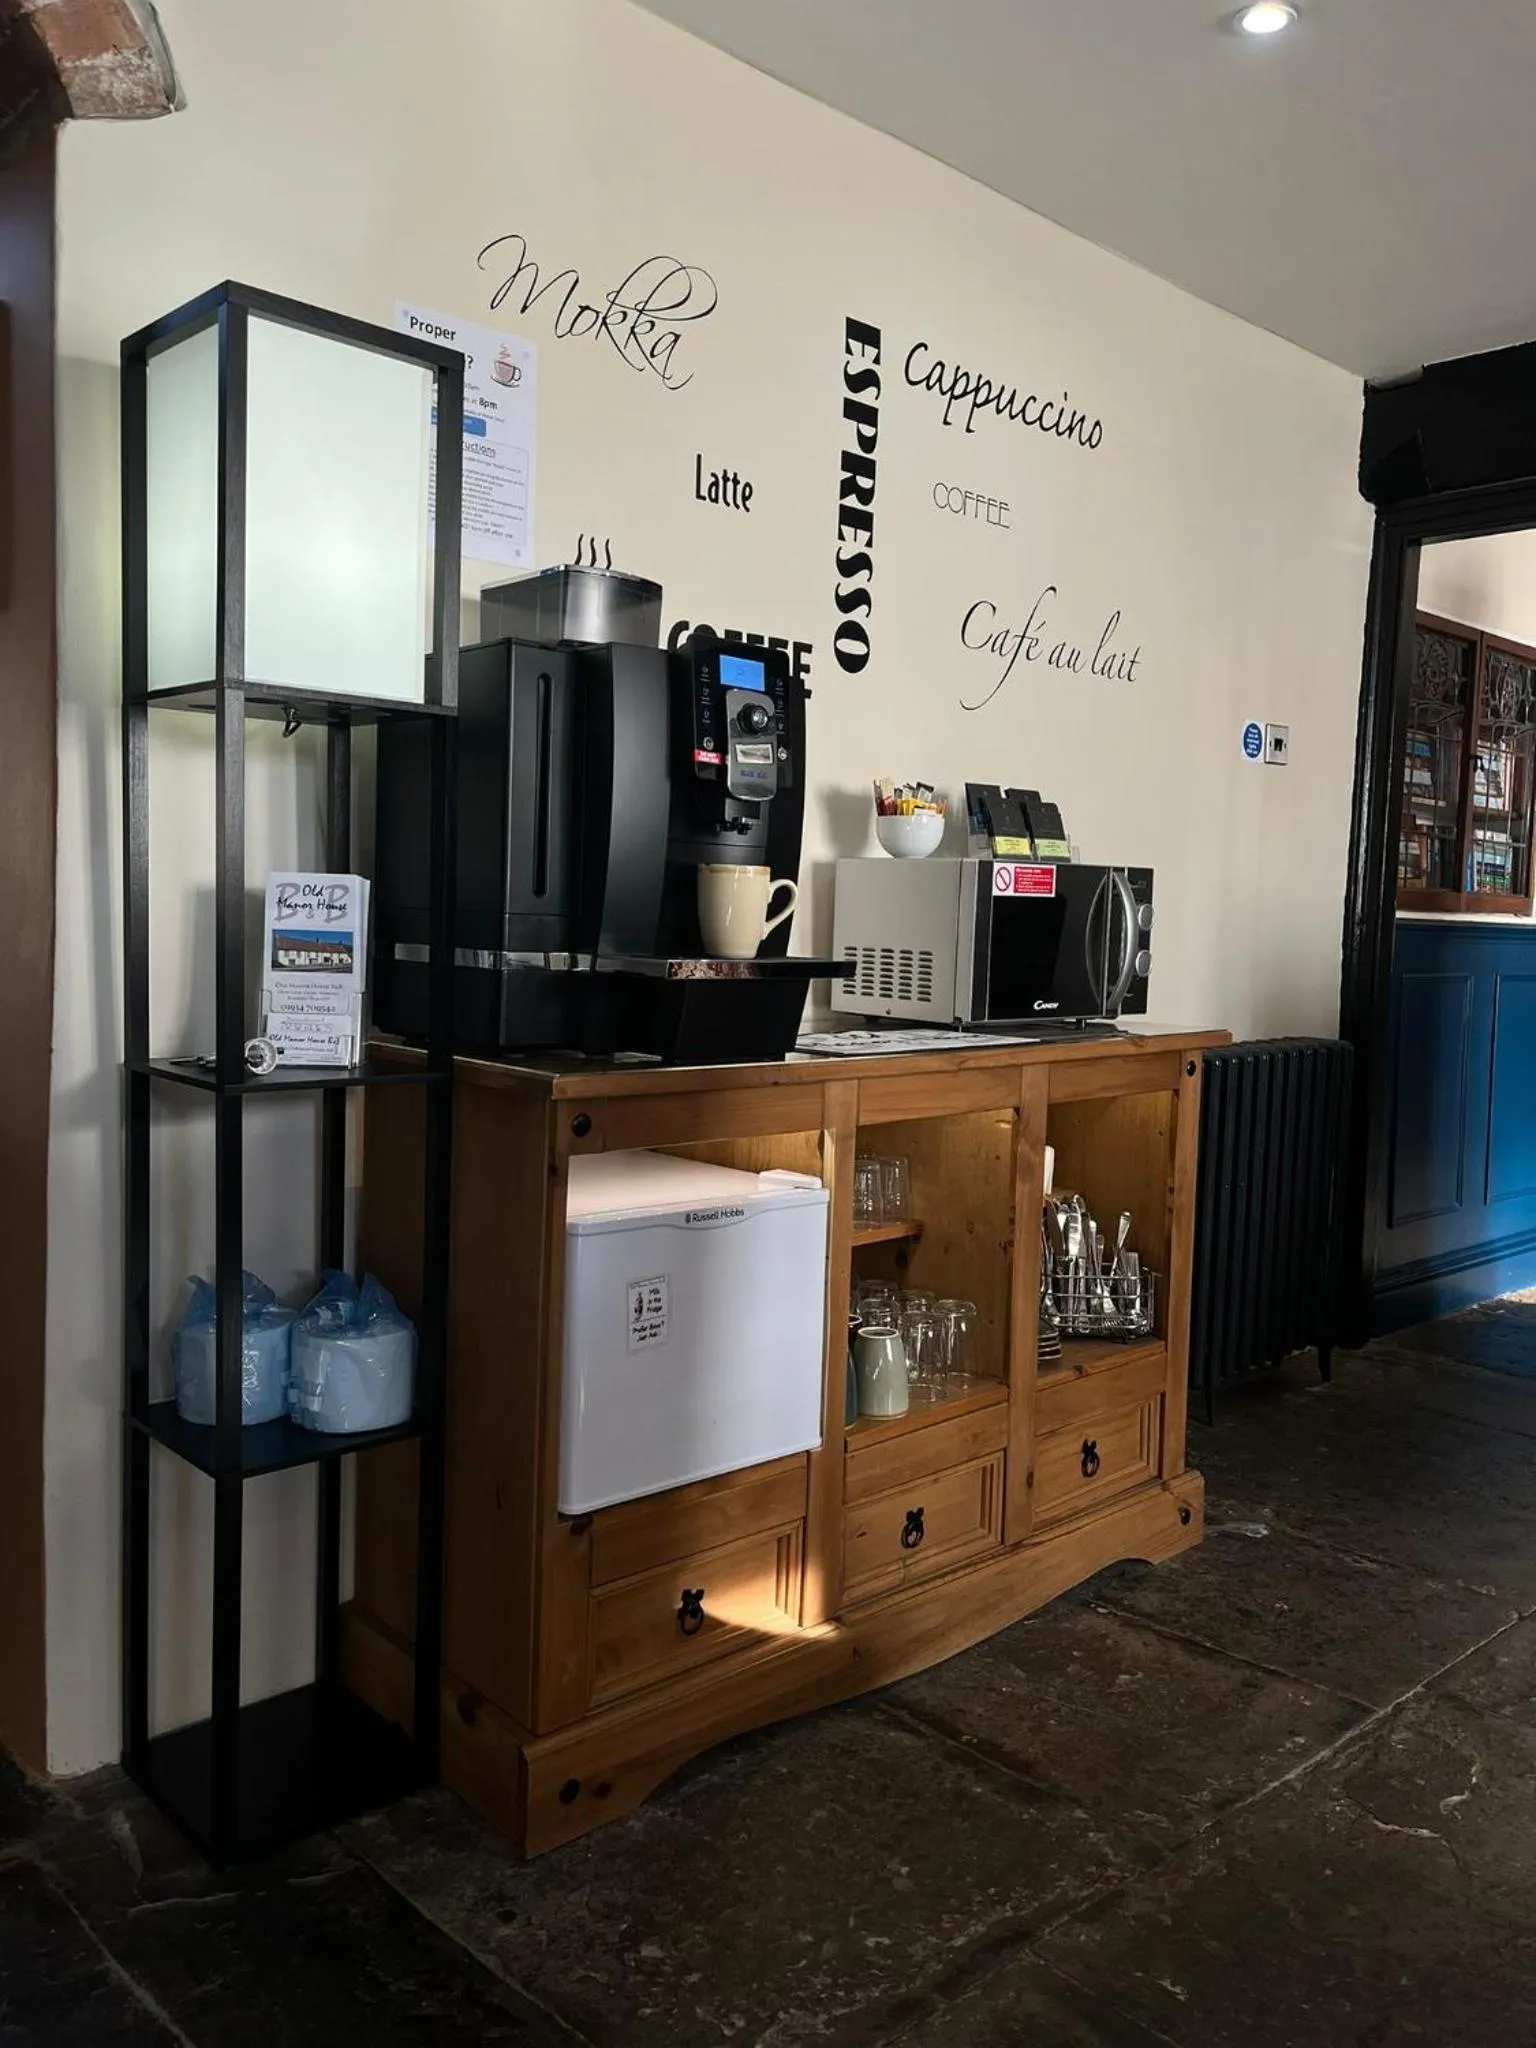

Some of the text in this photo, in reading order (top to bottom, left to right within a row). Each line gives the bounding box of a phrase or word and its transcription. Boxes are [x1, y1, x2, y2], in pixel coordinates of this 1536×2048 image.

[410, 315, 457, 341] Proper
[477, 235, 718, 390] Mokka
[479, 397, 498, 409] 8pm
[903, 341, 1103, 450] Cappuccino
[695, 453, 754, 513] Latte
[834, 315, 882, 675] ESPRESSO
[932, 482, 1011, 530] COFFEE
[959, 585, 1143, 711] Café au lait
[277, 896, 348, 911] Manor House
[302, 884, 324, 897] Old
[692, 1208, 745, 1223] Russell Hobbs
